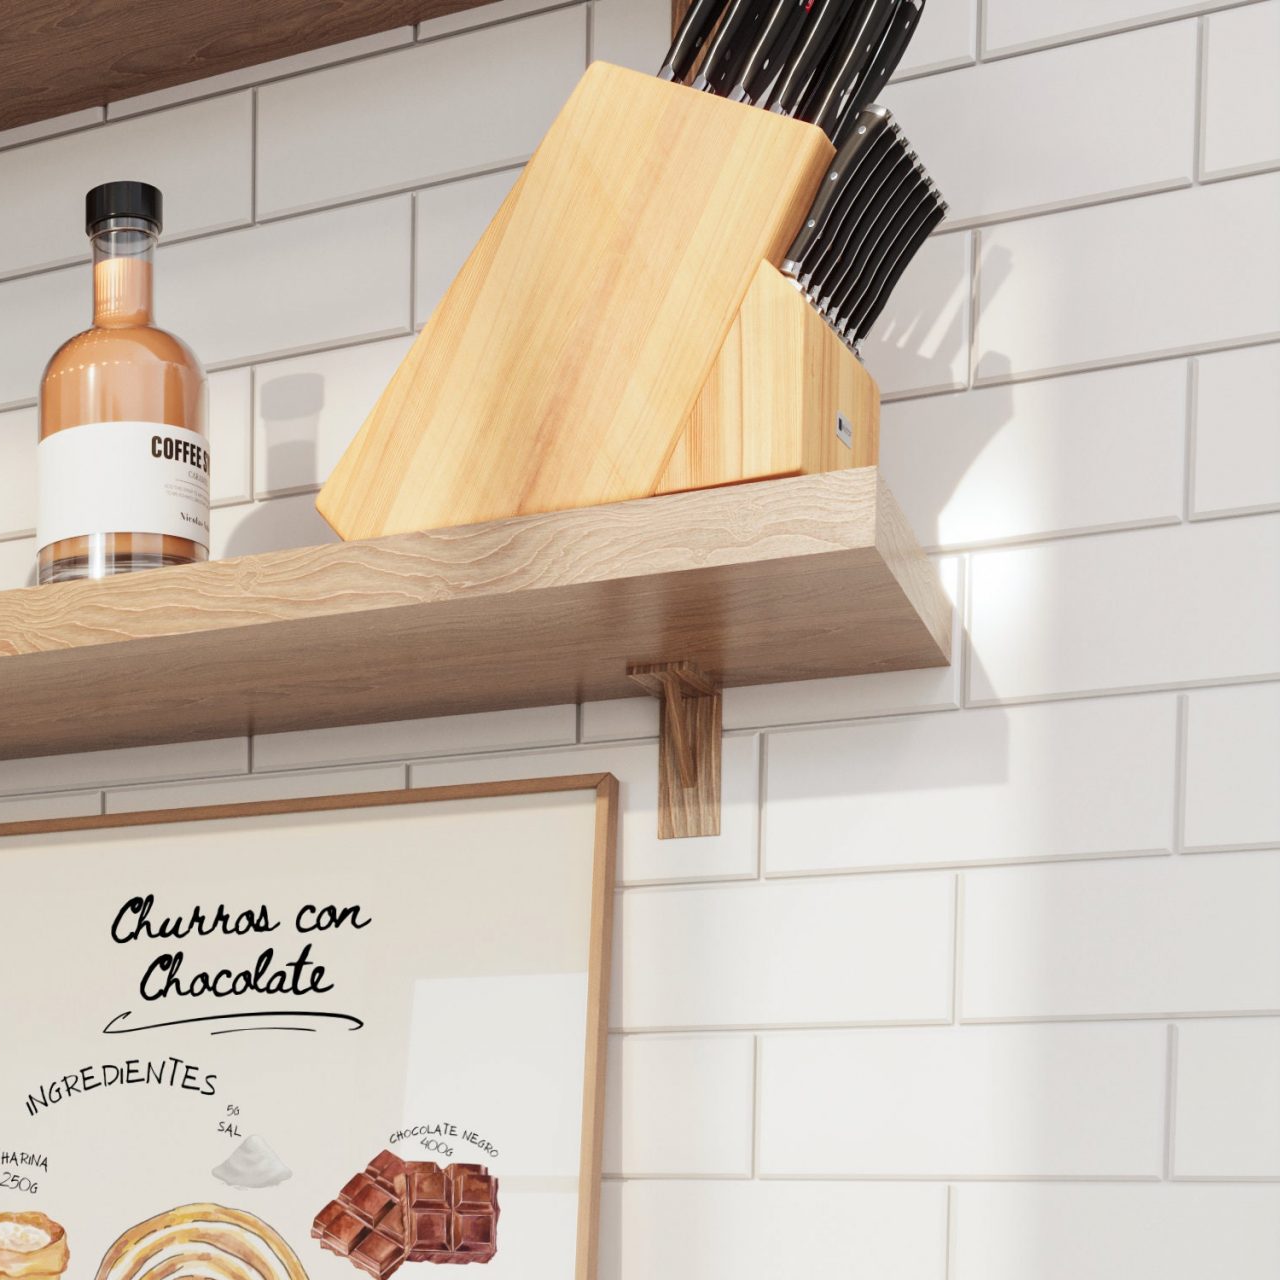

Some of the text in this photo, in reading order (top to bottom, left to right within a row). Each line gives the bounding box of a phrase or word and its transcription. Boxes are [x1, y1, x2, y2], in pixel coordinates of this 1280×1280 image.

[150, 435, 202, 469] COFFEE
[111, 894, 372, 944] Churros con
[139, 943, 335, 1001] Chocolate
[25, 1056, 218, 1117] INGREDIENTES
[226, 1104, 241, 1117] 5G
[217, 1121, 243, 1138] SAL
[389, 1122, 500, 1158] CHOCOLATE NEGRO
[420, 1137, 454, 1157] 400G
[0, 1151, 49, 1173] HARINA
[0, 1171, 39, 1194] 250G
